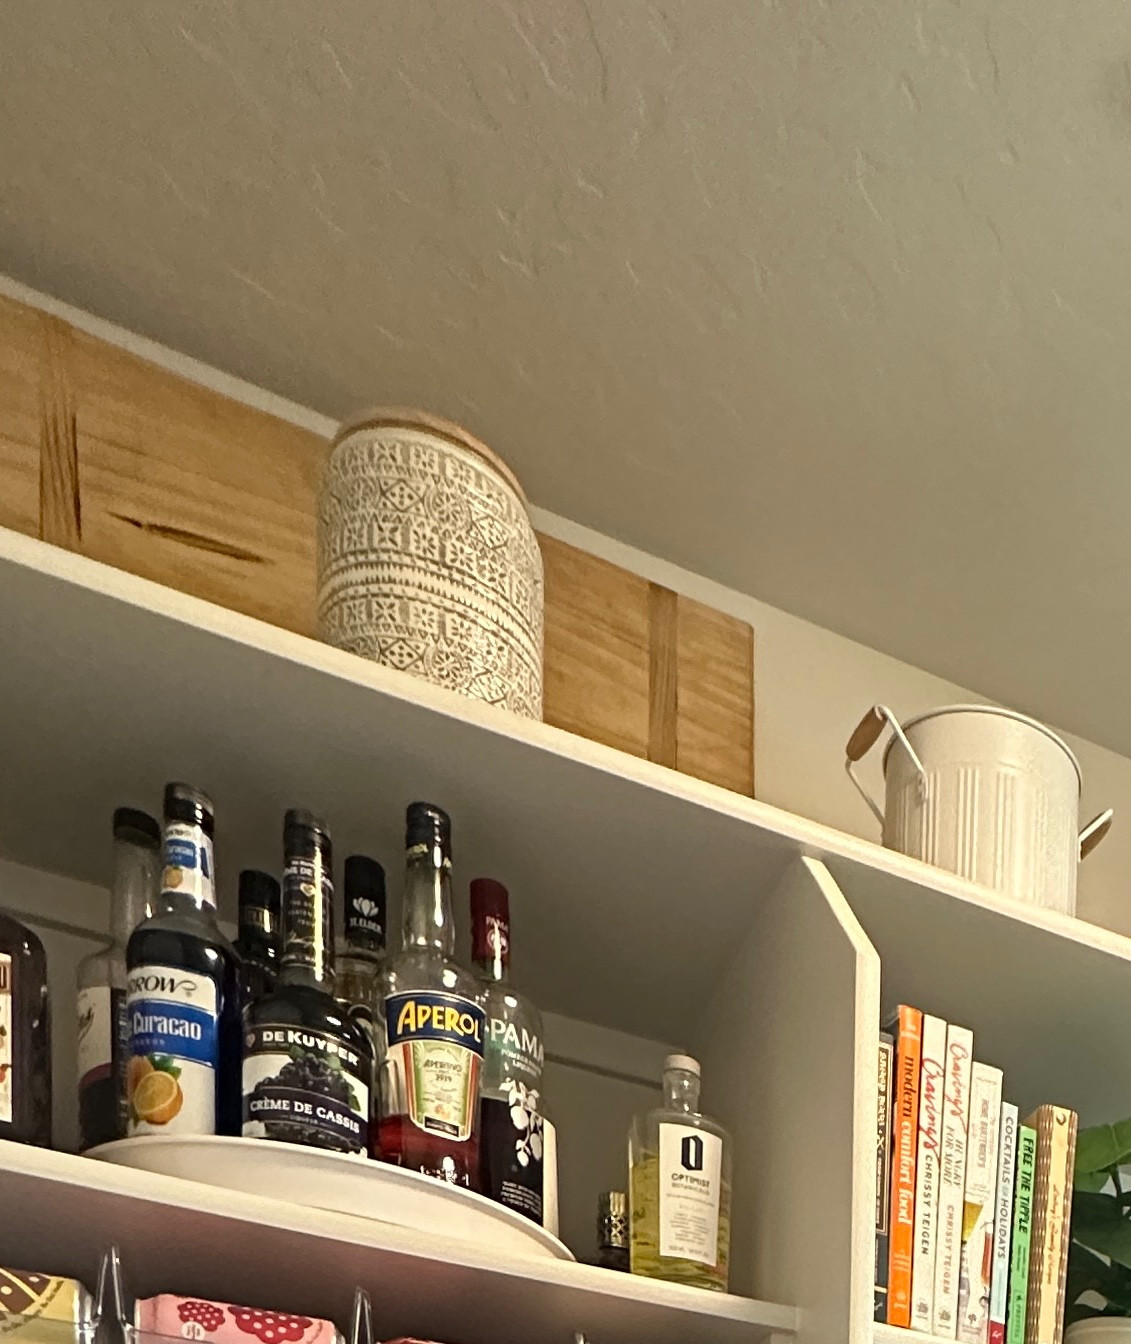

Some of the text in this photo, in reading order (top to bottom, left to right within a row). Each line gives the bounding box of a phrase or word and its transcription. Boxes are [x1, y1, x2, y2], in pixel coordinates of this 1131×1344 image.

[133, 1010, 202, 1041] Curacao
[262, 1030, 359, 1066] DE KUYPER
[396, 1000, 482, 1044] APEROL
[250, 1096, 290, 1111] CRÈME
[294, 1101, 313, 1115] DE
[316, 1107, 360, 1134] CASSIS
[918, 1057, 945, 1170] Cravings
[944, 1043, 968, 1134] Cravings
[671, 1172, 711, 1187] OPTIMIST
[898, 1055, 917, 1225] modern comfort food
[920, 1154, 933, 1255] CHRISSY TEIGEN
[997, 1115, 1014, 1258] COCKTAILS HOLIDAYS
[1018, 1136, 1034, 1235] FREE THE TIPPLE
[942, 1204, 955, 1294] CHRISSY TEIGEN
